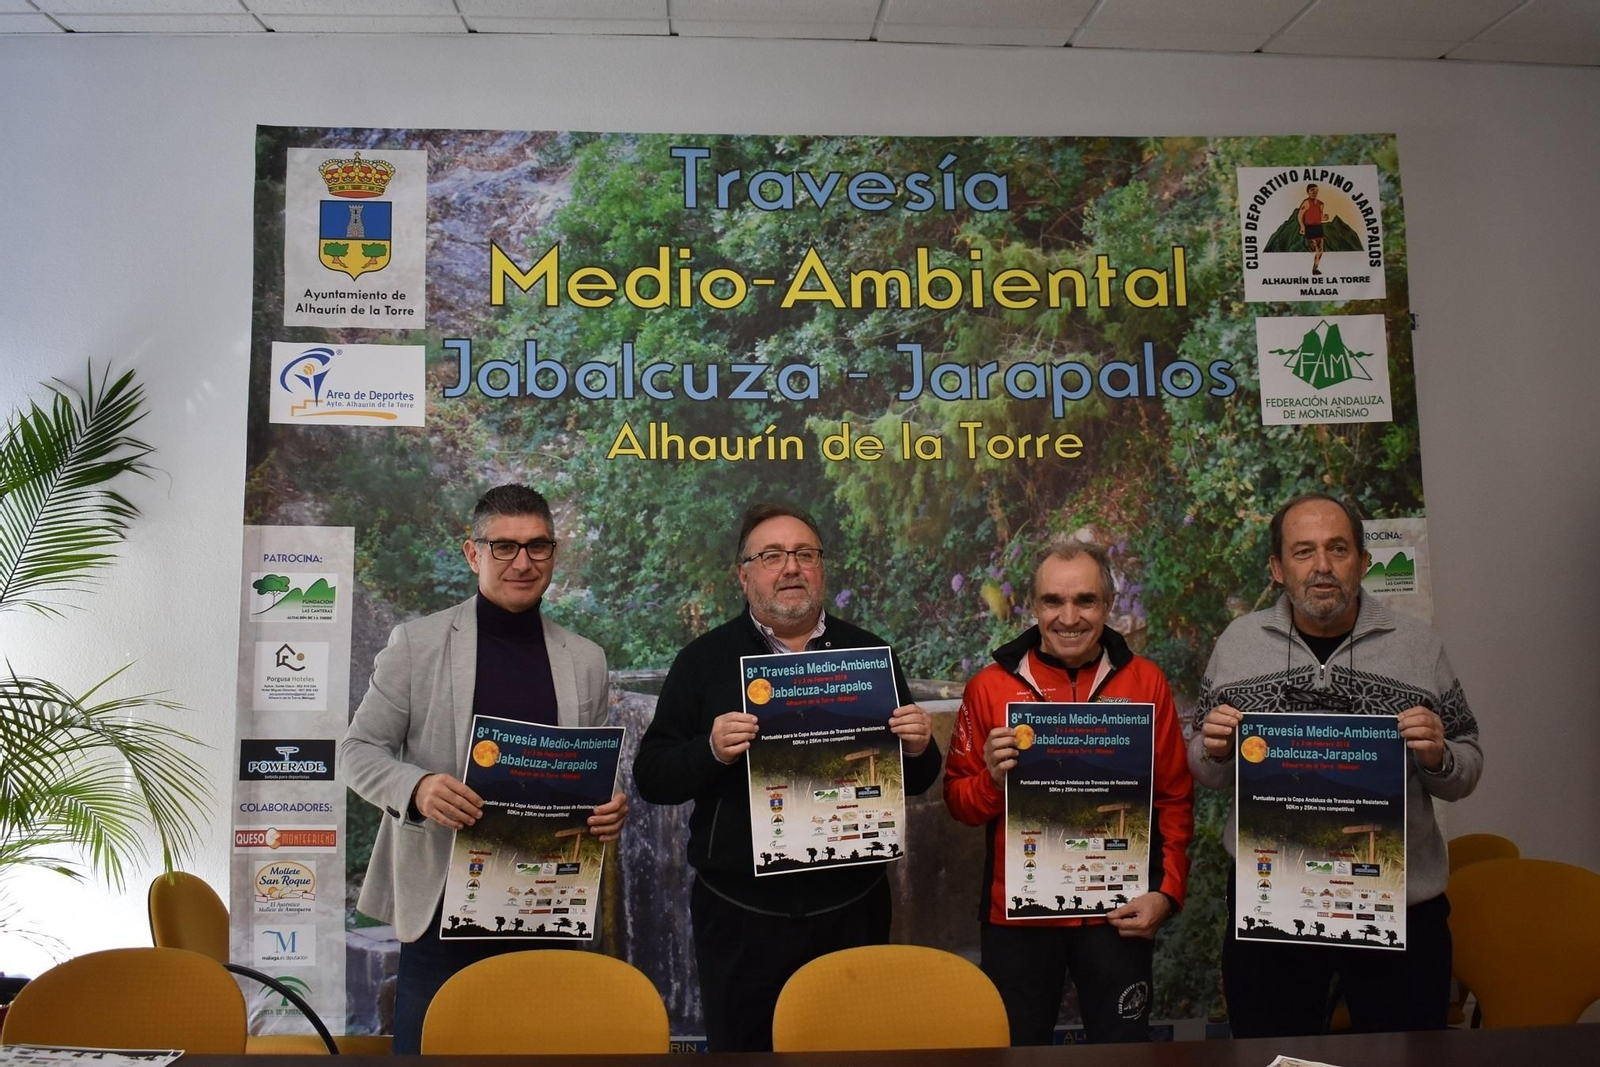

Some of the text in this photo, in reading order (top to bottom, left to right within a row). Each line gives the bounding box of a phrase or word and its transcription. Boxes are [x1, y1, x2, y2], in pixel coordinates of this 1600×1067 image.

[670, 146, 1010, 212] Travesía
[1245, 169, 1381, 270] CLUB DEPORTIVO ALPINO JARAPALOS
[489, 240, 1188, 310] Medio-Ambiental
[1262, 276, 1309, 285] ALHAURÍN
[304, 289, 406, 301] Ayuntamiento de
[1300, 288, 1338, 296] MÁLAGA
[296, 303, 414, 316] Alhaurín de la Torre
[442, 338, 821, 401] Jabalcuza
[896, 341, 1238, 419] Jarapalos
[327, 390, 414, 402] Area de Deportes
[1266, 395, 1384, 408] FEDERACIÓN ANDALUZA
[1283, 406, 1369, 419] DE MONTAÑISMO
[606, 421, 1084, 463] Alhaurín de la Torre
[1366, 532, 1402, 540] ROCINA:
[264, 554, 322, 563] PATROCINA:
[760, 663, 804, 677] Travesía
[807, 658, 888, 674] Medio-Ambiental
[770, 680, 872, 698] Jabalcuza-Jarapalos
[1025, 713, 1066, 724] Travesía
[1069, 714, 1149, 725] Medio-Ambiental
[1256, 725, 1303, 737] Travesía
[1306, 726, 1400, 739] Medio-Ambiental
[492, 729, 537, 746] Travesía
[540, 736, 619, 749] Medio-Ambiental
[1032, 734, 1130, 747] Jabalcuza-Jarapalos
[1265, 747, 1377, 762] Jabalcuza-Jarapalos
[494, 753, 598, 771] Jabalcuza-Jarapalos
[240, 803, 332, 812] COLABORADORES:
[236, 834, 264, 844] QUESO
[270, 867, 300, 875] Mollete
[259, 875, 311, 887] San Roque
